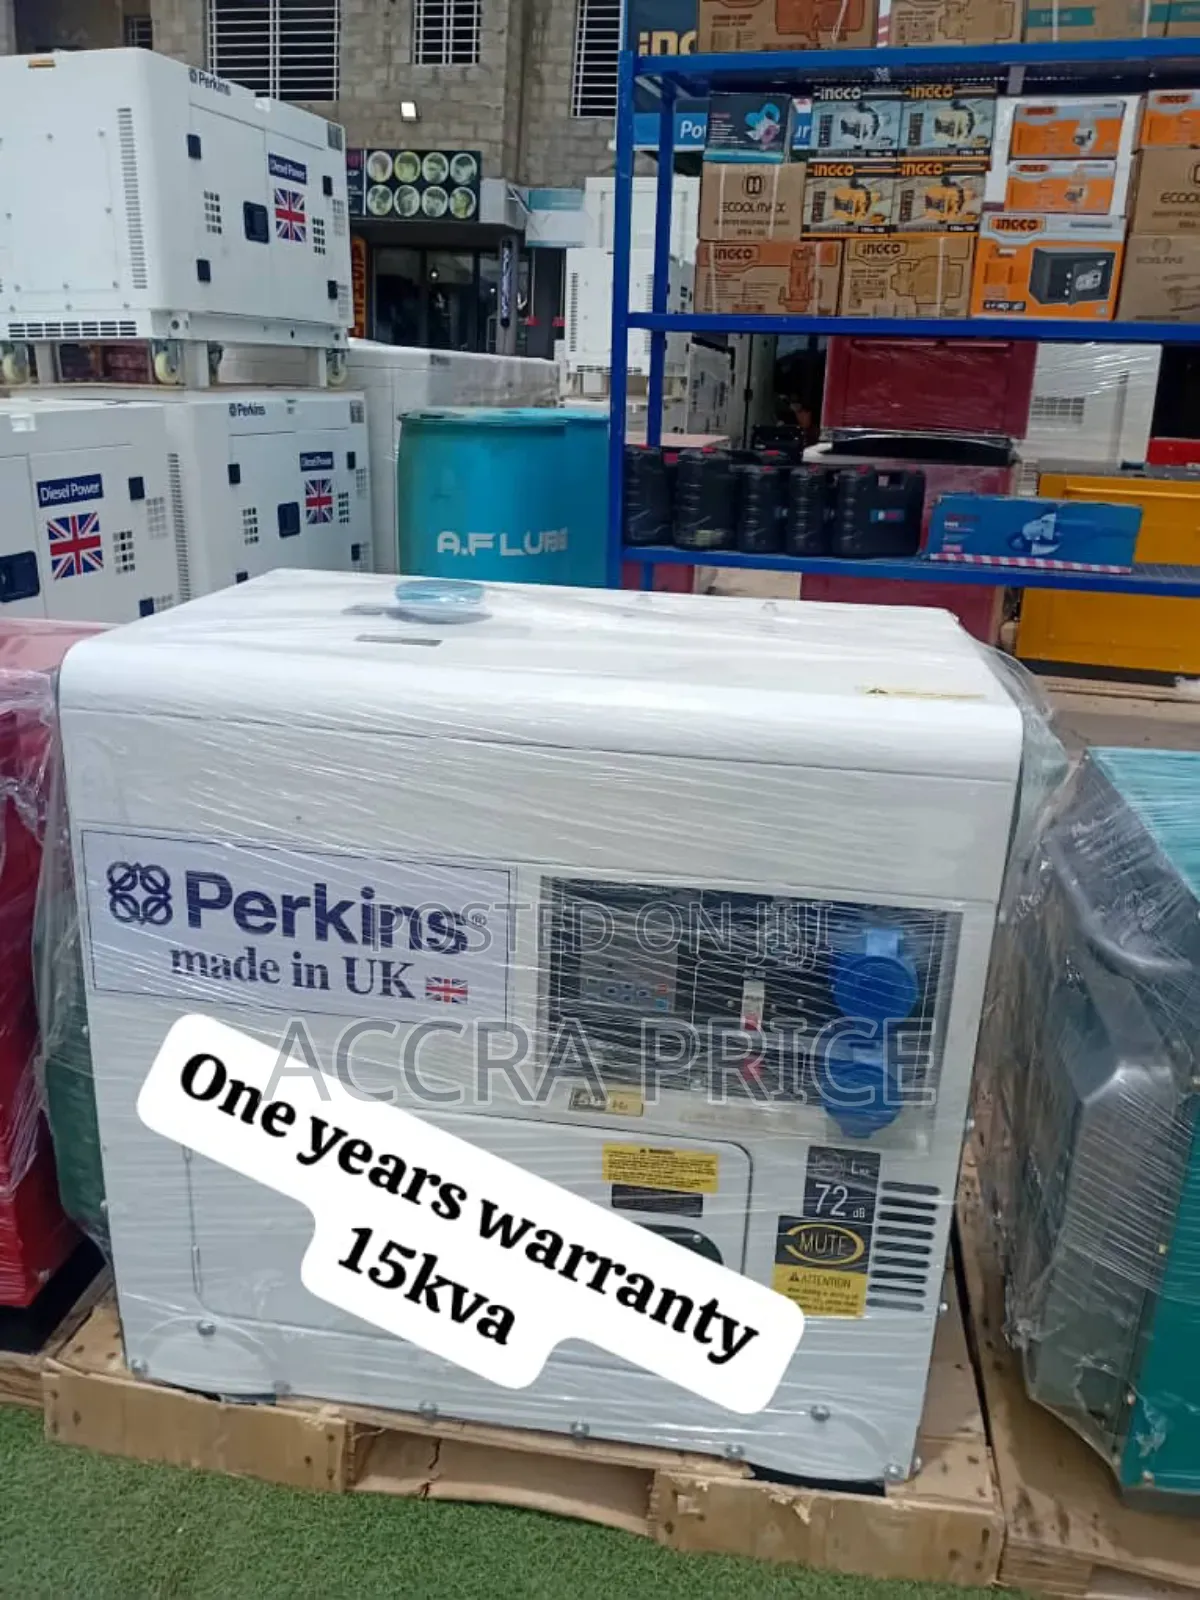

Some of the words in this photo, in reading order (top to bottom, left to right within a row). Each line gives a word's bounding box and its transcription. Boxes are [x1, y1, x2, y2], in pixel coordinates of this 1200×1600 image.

[680, 120, 706, 138] Po
[814, 164, 854, 177] INGCO
[902, 162, 943, 176] INGCO
[1160, 192, 1200, 205] ECOO
[862, 243, 902, 256] INGCO
[169, 946, 281, 985] made
[291, 950, 331, 992] in
[341, 956, 416, 999] UK
[815, 1183, 848, 1217] 72
[799, 1231, 850, 1257] MUTE
